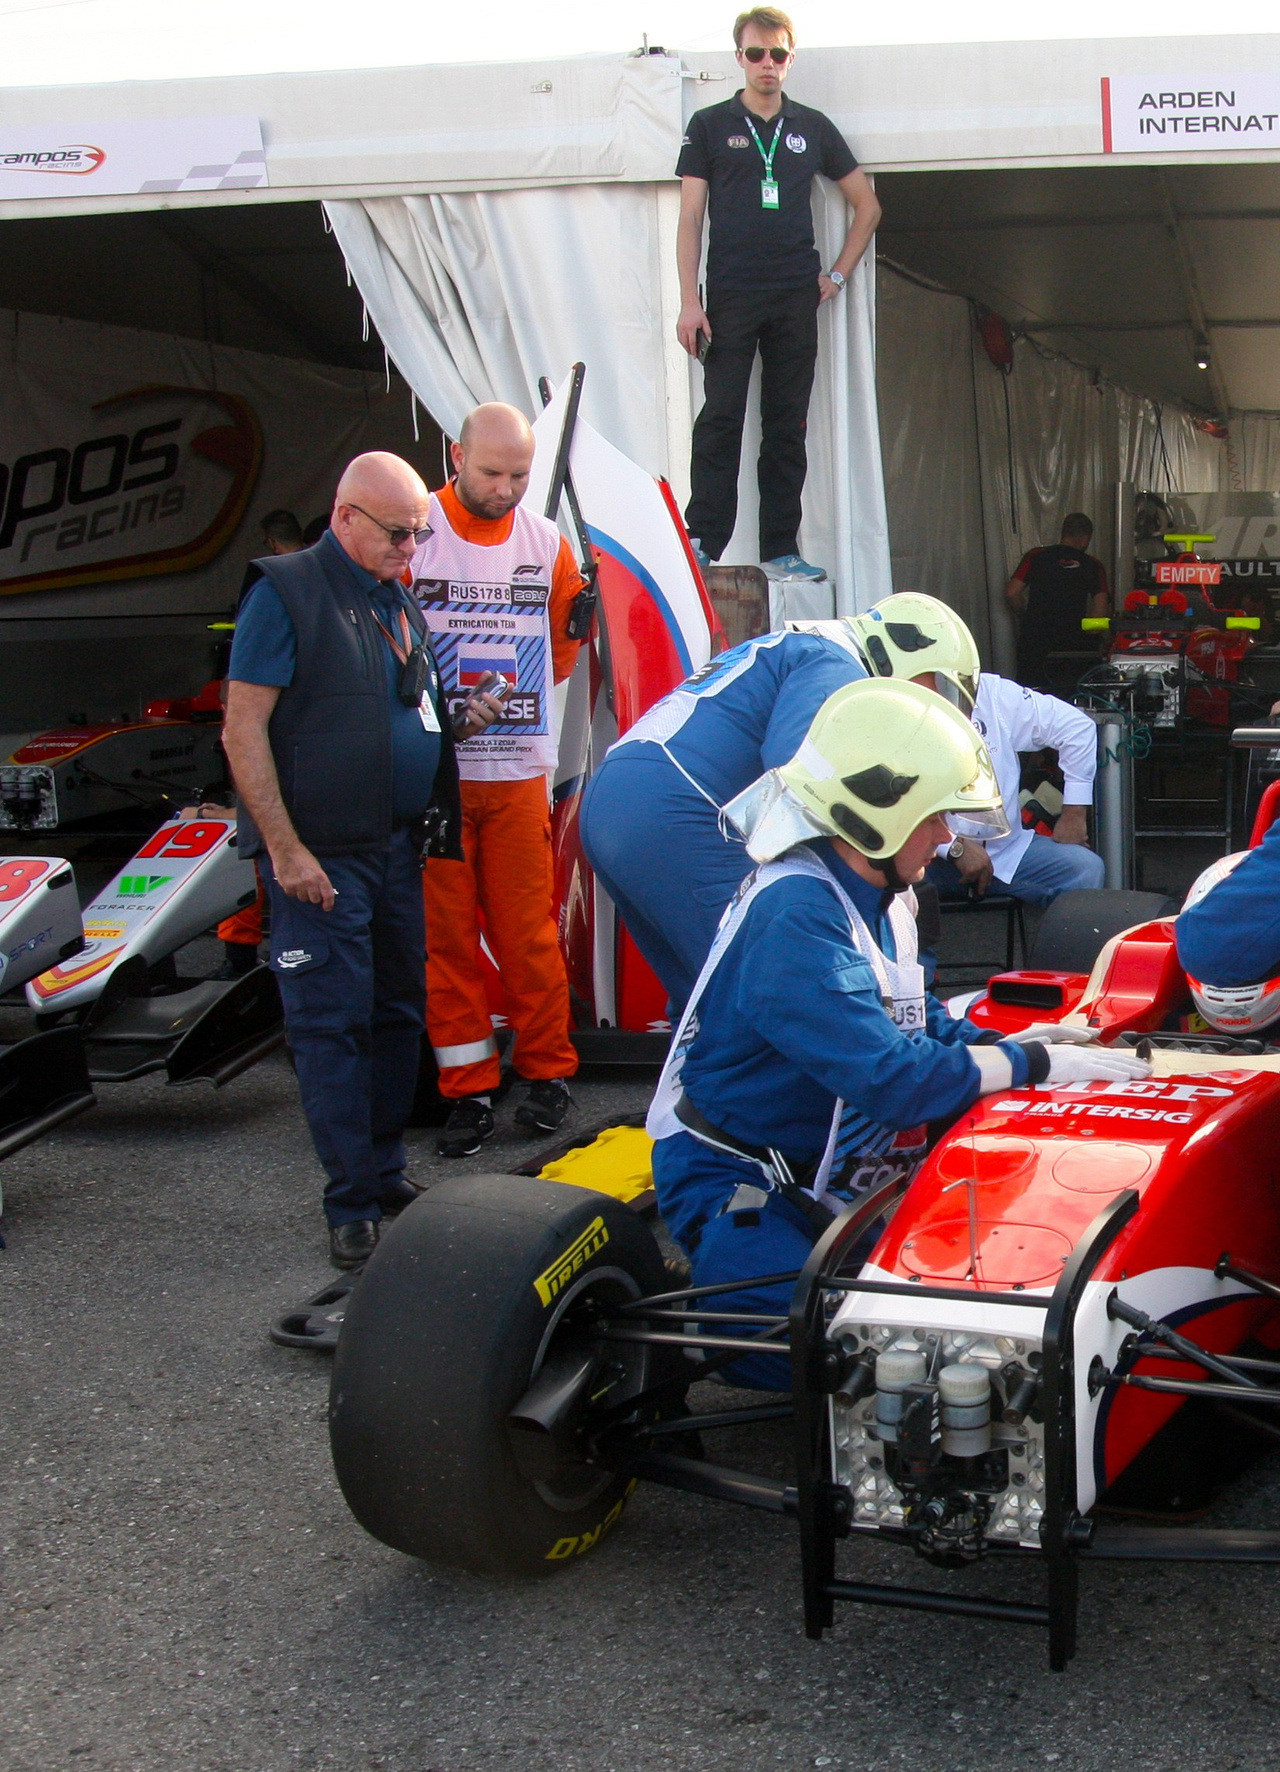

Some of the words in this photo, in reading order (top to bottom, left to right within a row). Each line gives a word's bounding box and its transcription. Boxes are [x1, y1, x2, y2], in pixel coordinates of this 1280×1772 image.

[1138, 90, 1236, 109] ARDEN
[728, 137, 749, 147] FIA
[39, 161, 83, 169] racing
[0, 418, 182, 550] pos
[20, 485, 186, 563] racing
[1161, 566, 1218, 583] EMPTY
[448, 619, 498, 629] EXTRICATION
[135, 822, 229, 859] 19
[0, 859, 50, 902] 8
[533, 1215, 610, 1309] PIRELLI
